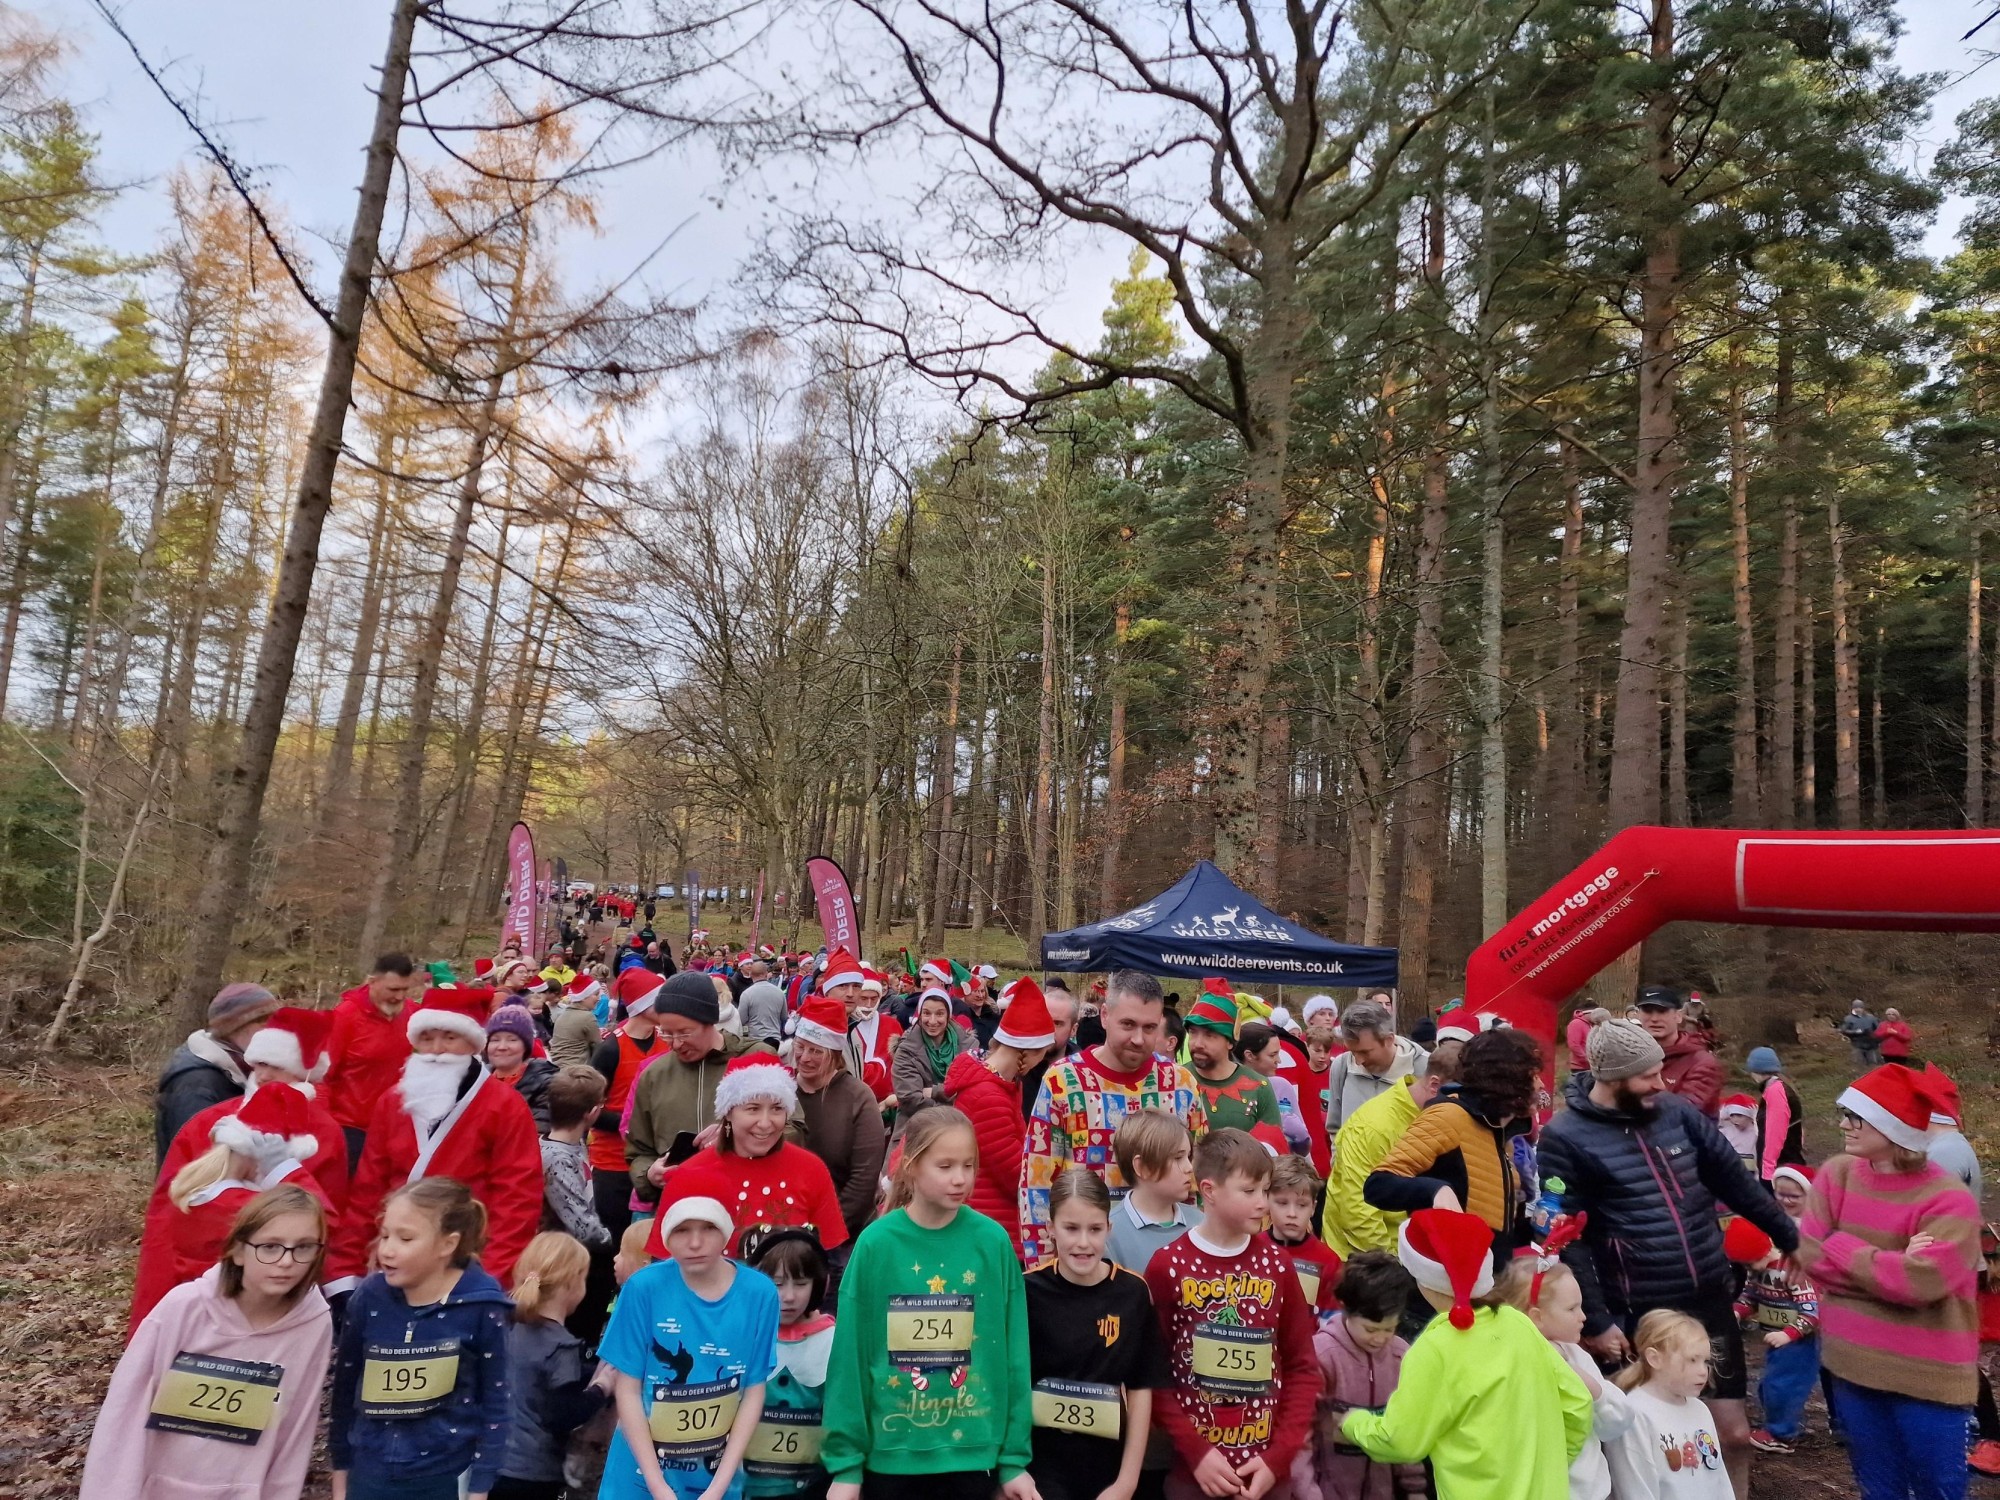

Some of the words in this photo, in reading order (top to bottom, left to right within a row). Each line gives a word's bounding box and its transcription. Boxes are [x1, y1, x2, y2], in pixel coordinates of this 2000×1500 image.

[1173, 928, 1231, 938] WILD
[1235, 927, 1296, 941] DEER
[1526, 895, 1634, 979] www.firstmortgage.co.uk
[1534, 935, 1559, 959] FREE
[1558, 902, 1601, 937] Mortgage
[1160, 951, 1344, 974] www.wilddeerevents.co.uk
[1181, 1271, 1275, 1312] Rocking
[1767, 1310, 1789, 1324] 178
[912, 1318, 954, 1341] 254
[1212, 1327, 1227, 1337] WILD
[1228, 1329, 1243, 1338] DEER
[1243, 1330, 1263, 1340] EVENTS
[411, 1345, 437, 1355] EVENTS
[1216, 1347, 1257, 1371] 255
[196, 1360, 216, 1370] WILD
[215, 1363, 235, 1373] DEER
[235, 1366, 261, 1378] EVENTS
[382, 1366, 427, 1391] 195
[189, 1383, 246, 1413] 226
[671, 1389, 688, 1397] WILD
[688, 1388, 705, 1396] DEER
[705, 1383, 727, 1394] EVENTS
[1050, 1382, 1064, 1391] WILD
[1065, 1384, 1081, 1393] DEER
[1081, 1386, 1103, 1395] EVENTS
[764, 1410, 779, 1419] WILD
[779, 1412, 794, 1420] DEER
[892, 1385, 977, 1426] Jingle
[1053, 1402, 1095, 1427] 283
[676, 1403, 721, 1432] 307
[771, 1431, 799, 1453] 26
